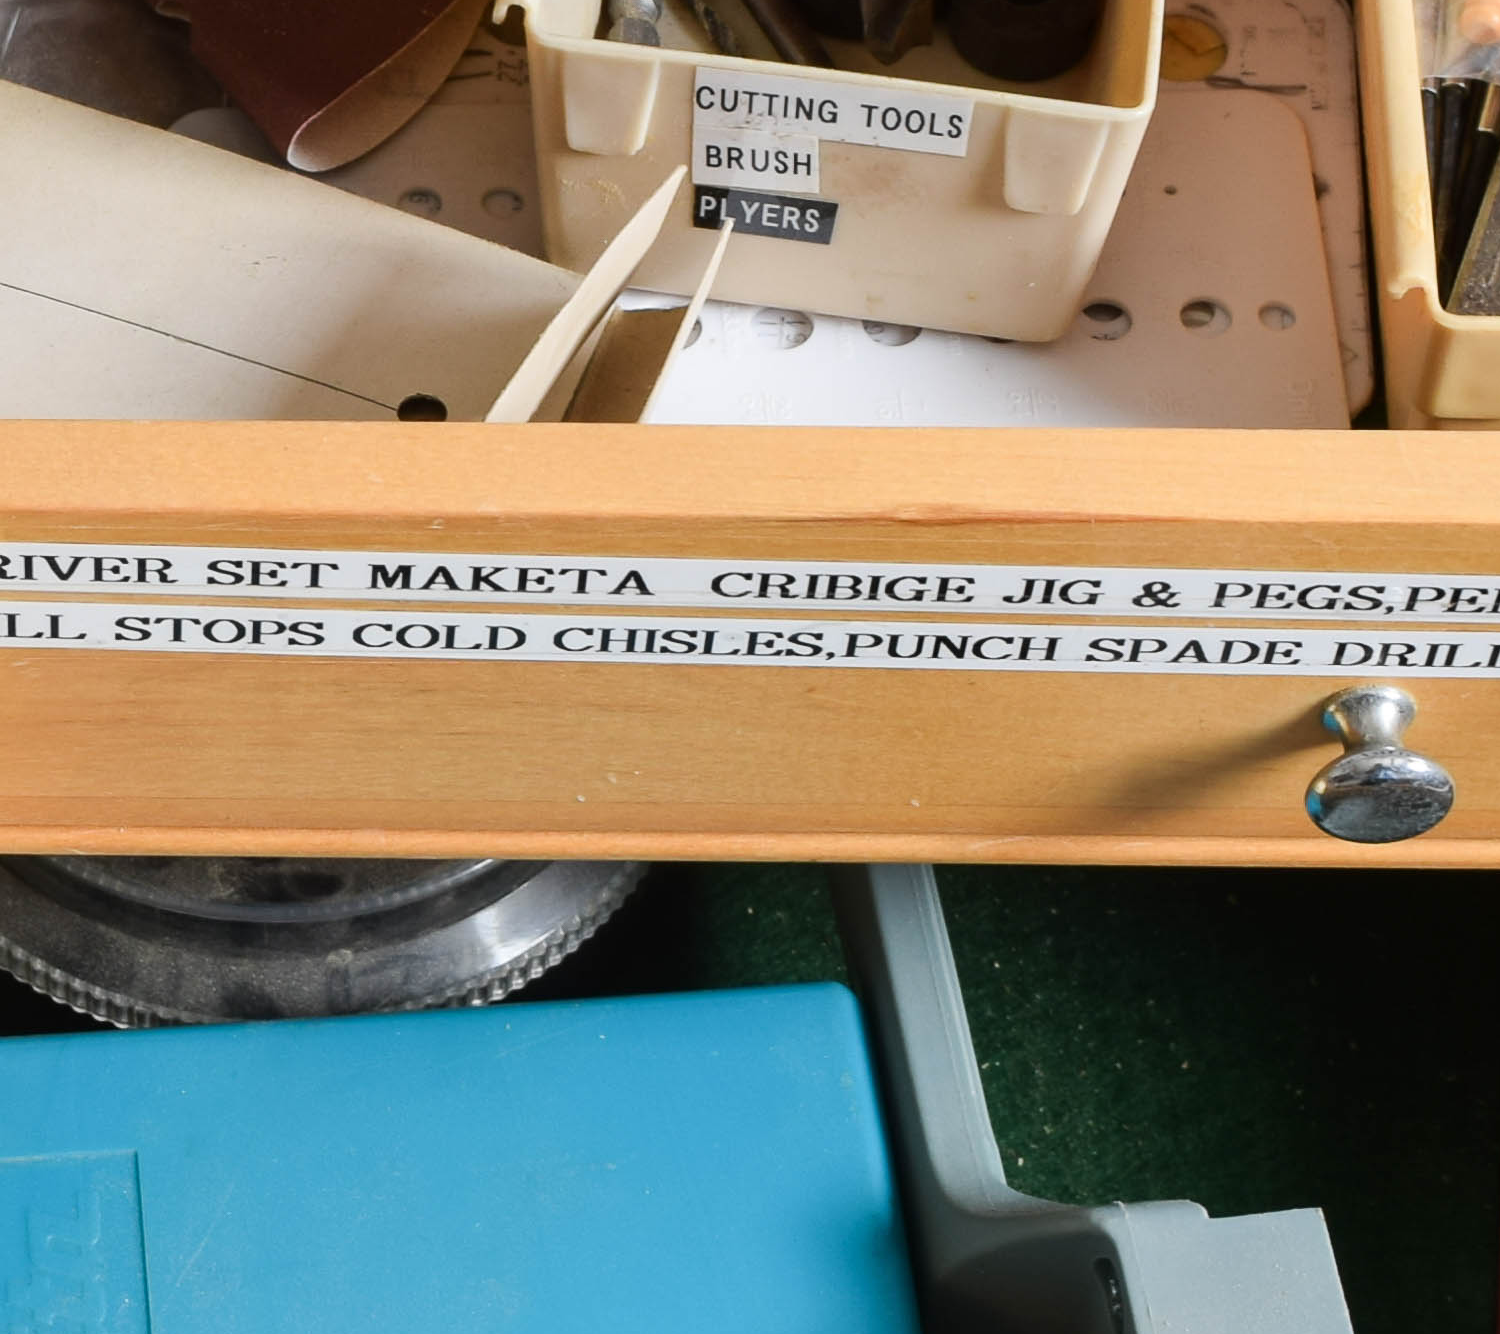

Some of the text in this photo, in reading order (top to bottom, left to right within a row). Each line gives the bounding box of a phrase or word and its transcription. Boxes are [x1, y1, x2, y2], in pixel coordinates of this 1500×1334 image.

[696, 85, 964, 139] CUTTING TOOLS
[706, 145, 812, 176] BRUSH
[700, 195, 820, 233] PLYERS
[206, 558, 338, 589] SET
[368, 563, 655, 596] MAKETA
[710, 571, 975, 604] CRIBIGE
[1003, 578, 1104, 606] JIG
[1131, 581, 1181, 609] &
[113, 617, 326, 646] STOPS
[351, 622, 527, 652] COLD
[552, 628, 1063, 662] CHISLES,PUNCH
[1085, 638, 1303, 665] SPADE
